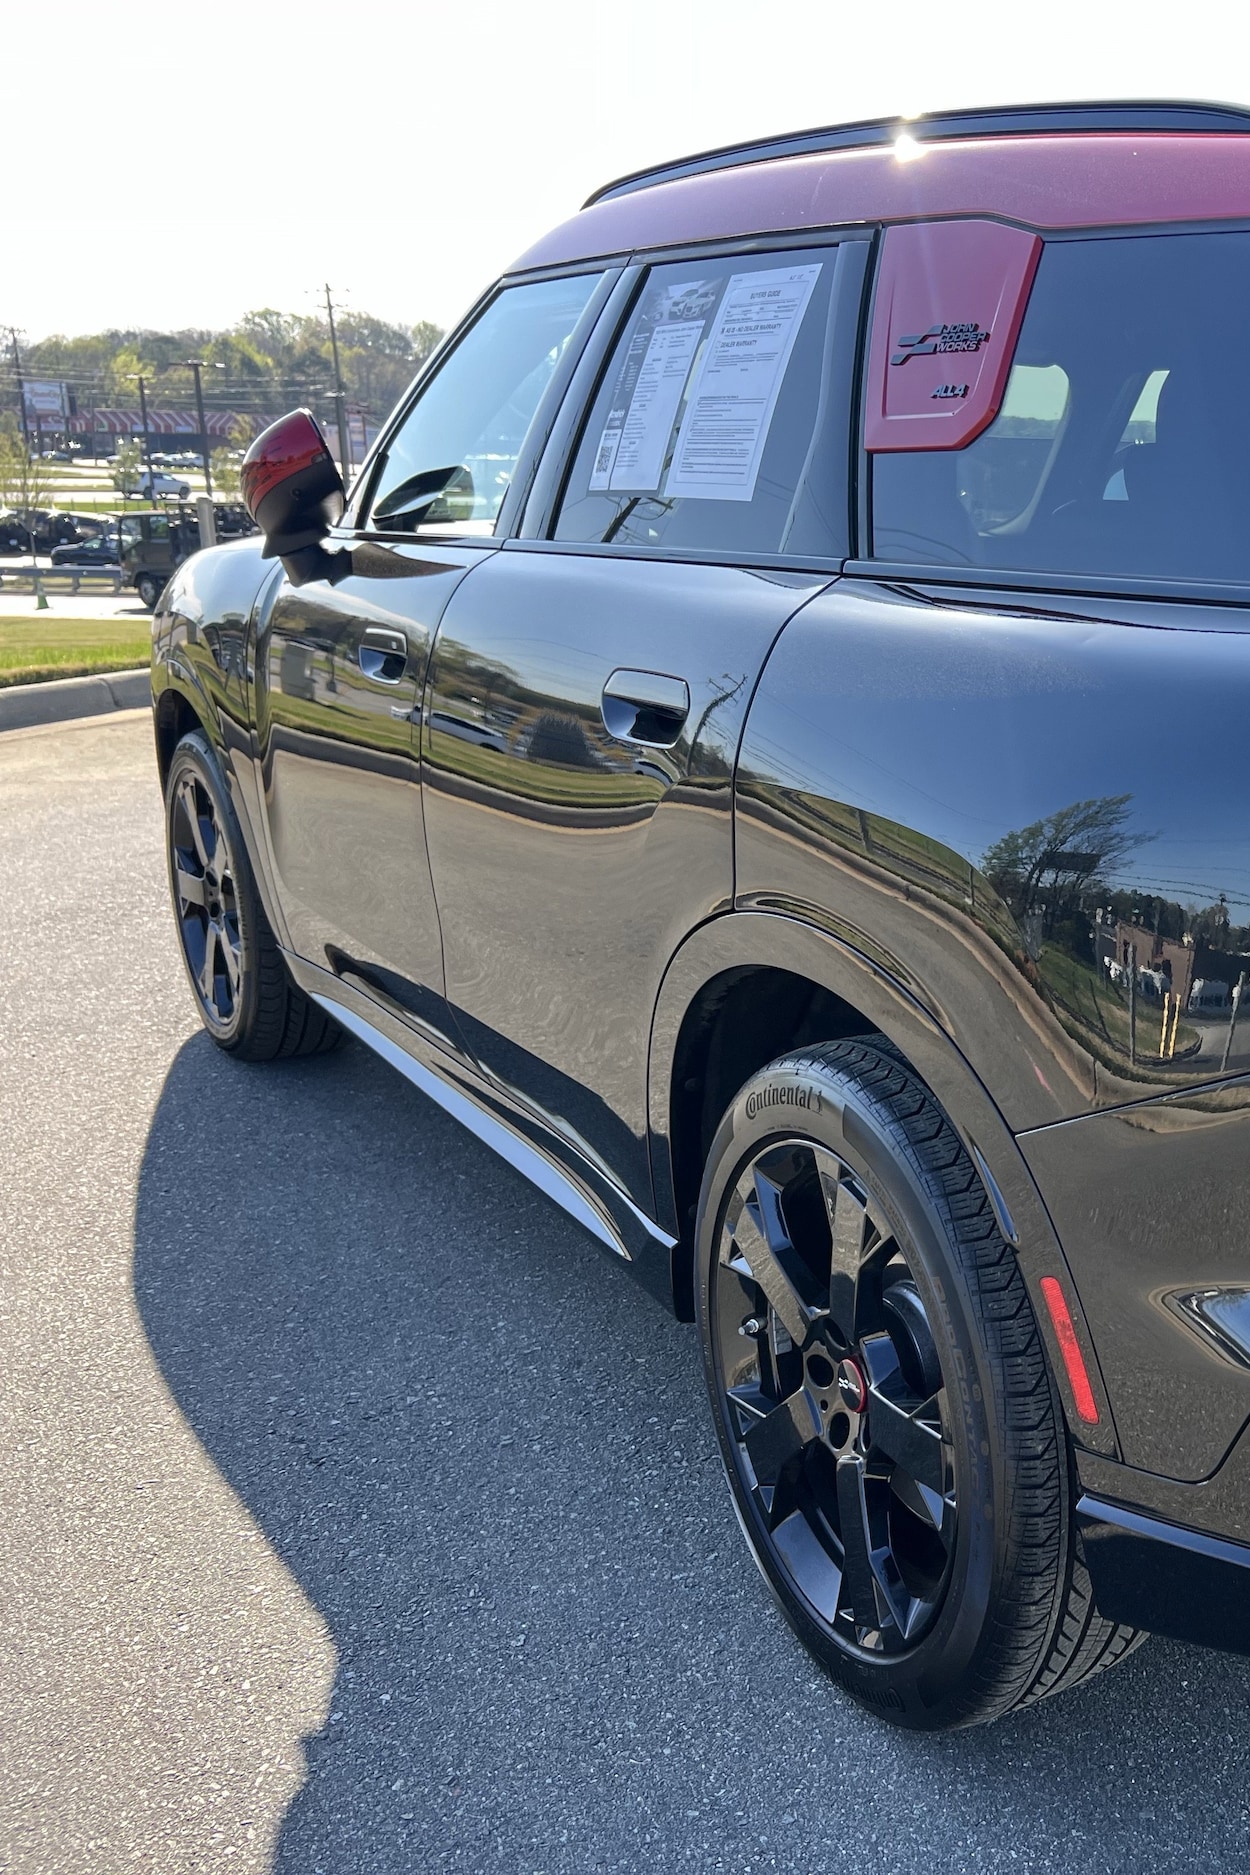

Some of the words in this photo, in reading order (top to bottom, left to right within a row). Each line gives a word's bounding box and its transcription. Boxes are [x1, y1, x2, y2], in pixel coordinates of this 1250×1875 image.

[760, 323, 782, 331] WARRANTY
[942, 323, 979, 333] JOHN
[940, 332, 989, 342] COOPER
[936, 341, 980, 353] WORKS
[745, 1083, 813, 1120] Continental
